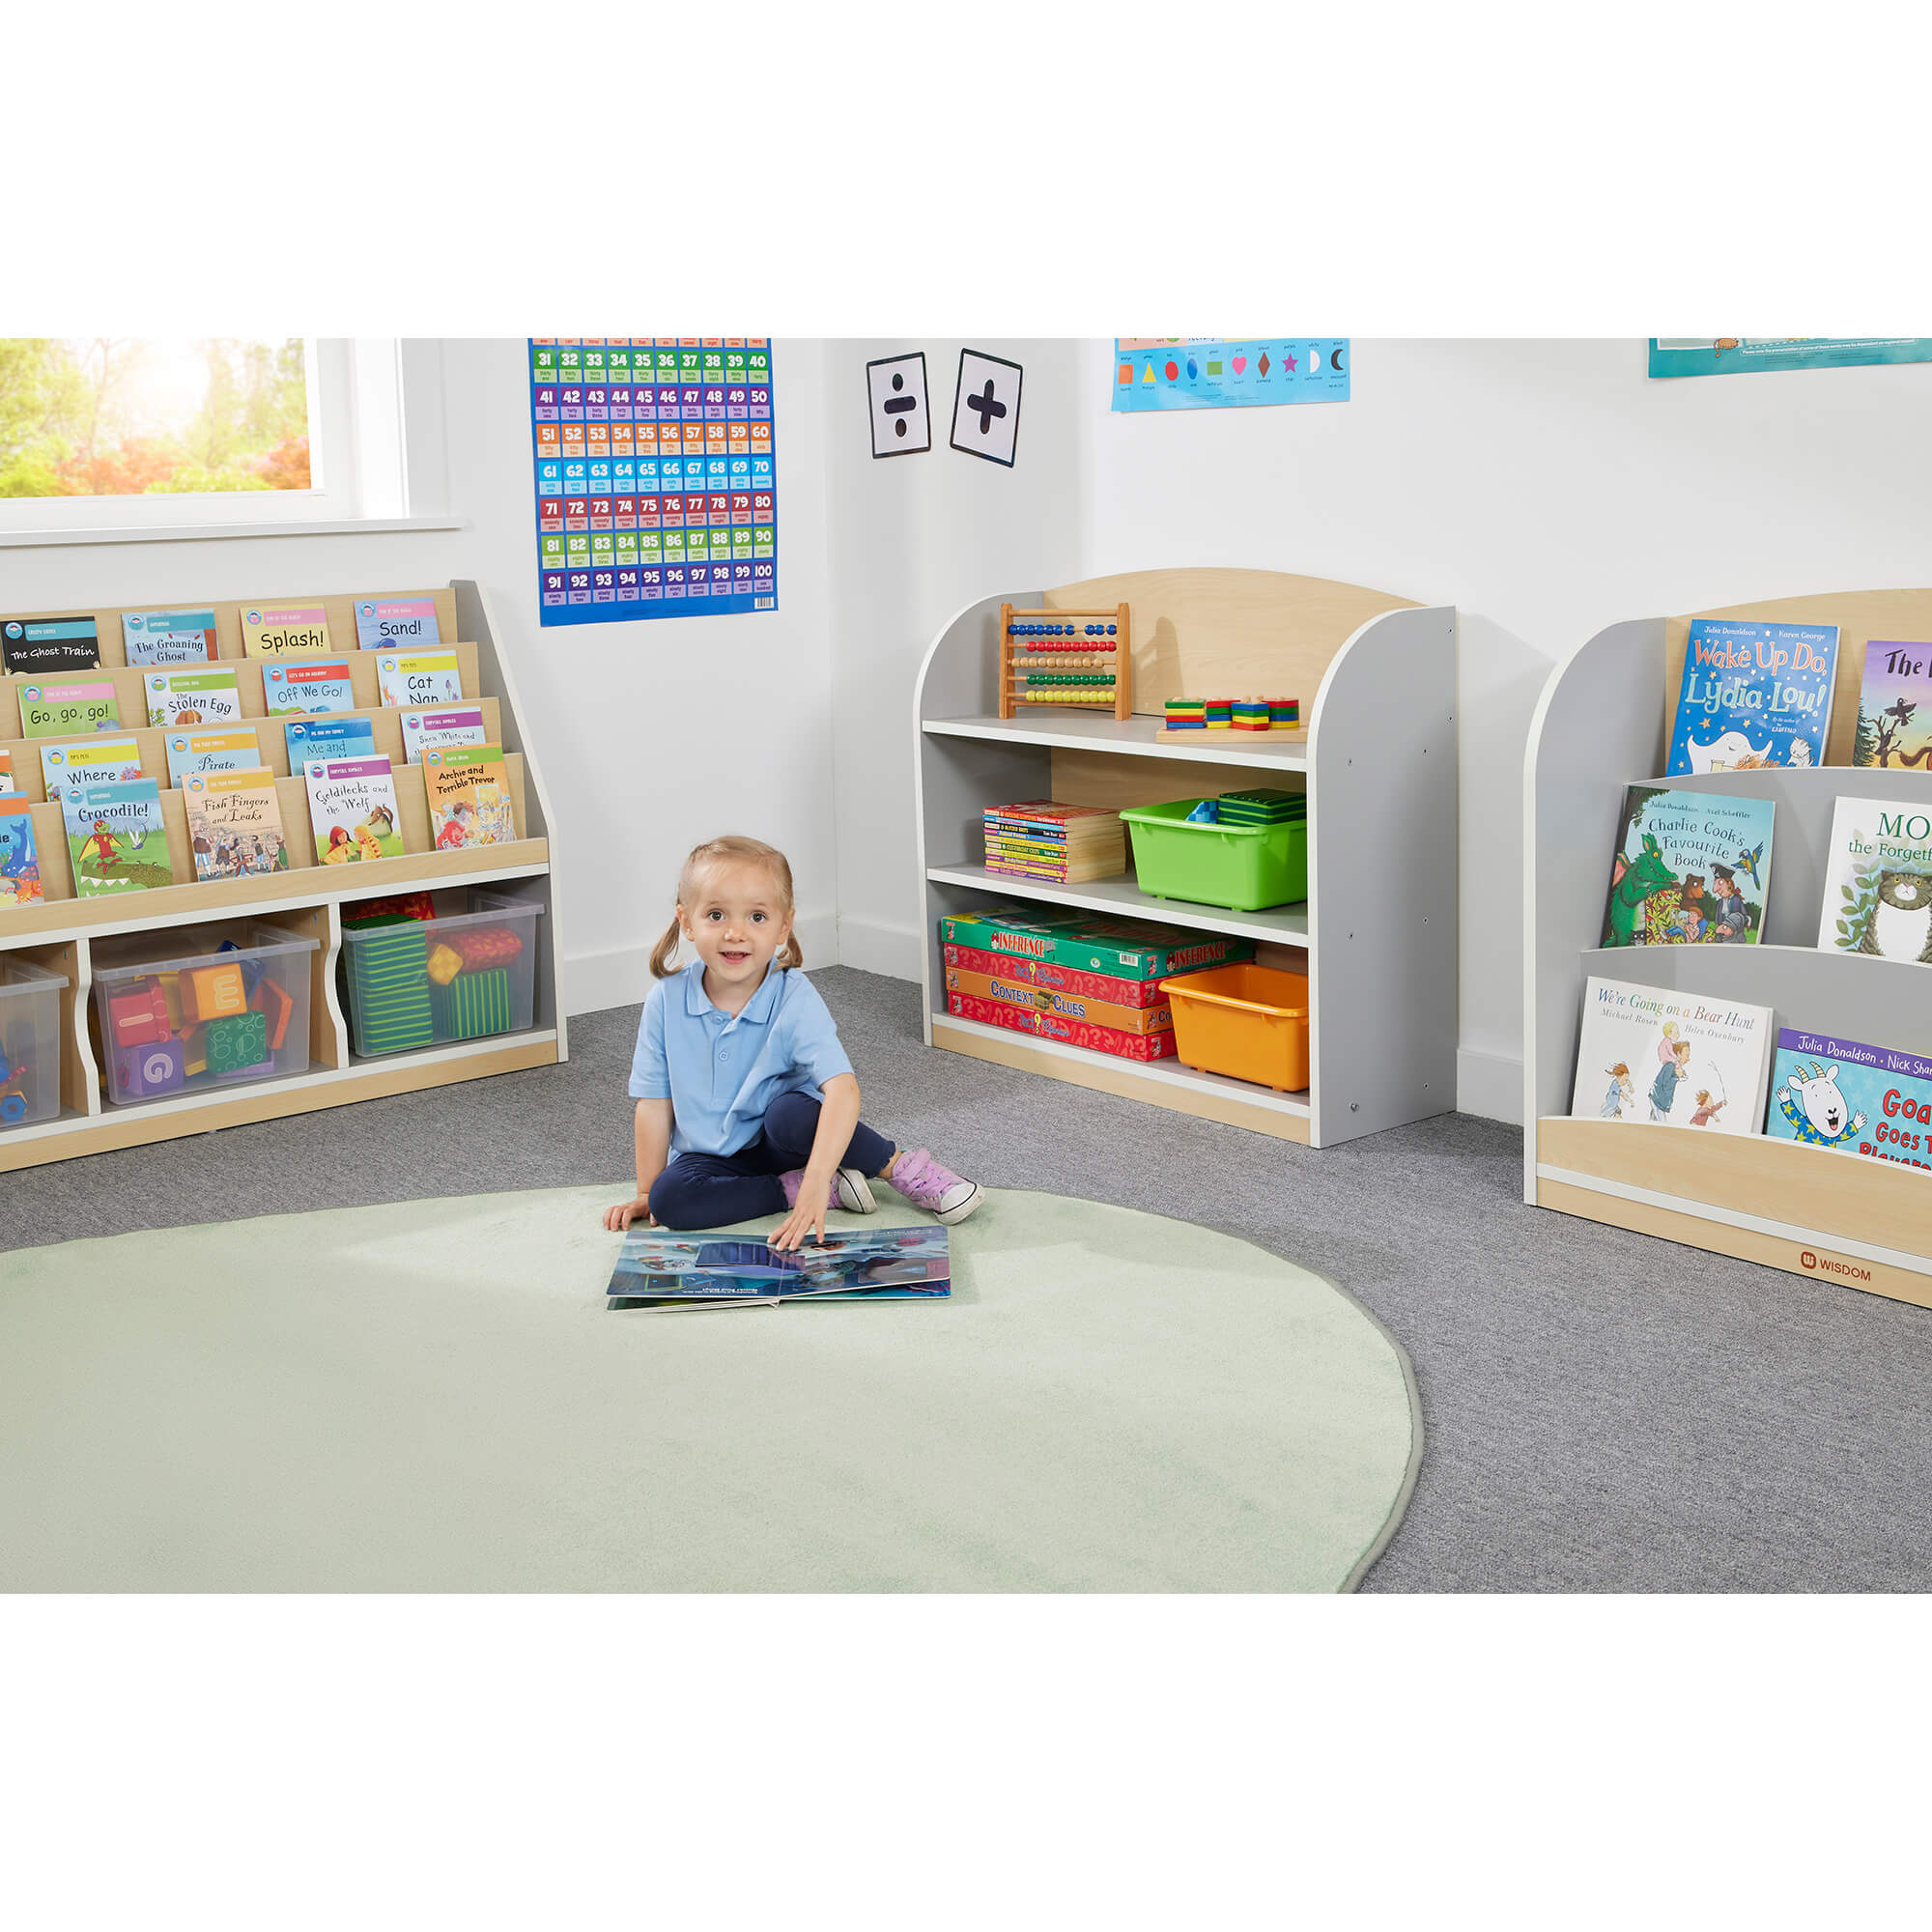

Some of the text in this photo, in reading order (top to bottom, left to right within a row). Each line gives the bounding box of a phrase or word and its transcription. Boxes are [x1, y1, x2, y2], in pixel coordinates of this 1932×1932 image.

[539, 354, 765, 367] 31 32 33 34 35 36 37 38 39 40
[541, 390, 767, 403] 41 42 43 44 45 46 47 48 49 50
[543, 426, 768, 440] 51 52 53 54 55 56 57 58 59 60
[544, 462, 769, 477] 61 62 63 64 65 66 67 68 69 70
[546, 496, 770, 514] 71 72 73 74 75 76 77 78 79 80
[548, 531, 771, 552] 81 82 83 84 85 86 87 88 89 90
[549, 565, 772, 588] 91 92 93 94 95 96 97 98 99 100
[380, 620, 421, 637] Sand!
[1722, 627, 1756, 636] Donaldson
[1802, 633, 1825, 641] George
[134, 639, 204, 654] The Groaning
[261, 630, 324, 653] Splash!
[11, 644, 95, 662] The Ghost Train
[156, 651, 186, 662] Ghost
[1693, 639, 1827, 676] Wake Up Do,
[1885, 649, 1923, 677] The
[409, 676, 433, 689] Cat
[277, 684, 343, 703] Off We Go!
[1685, 673, 1827, 717] Lydia Lou!
[31, 704, 108, 724] Go, go, go!
[168, 697, 232, 715] Stolen Egg
[307, 741, 346, 755] Me and
[198, 754, 235, 771] Pirate
[67, 770, 116, 784] Where
[439, 771, 466, 781] Archie
[316, 782, 368, 805] Goldilocks
[437, 777, 495, 795] Terrible Trevor
[202, 794, 269, 811] Fish Fingers
[342, 798, 370, 812] Wolf
[1650, 801, 1698, 812] Julia Donaldson
[78, 804, 149, 822] Crocodile!
[213, 814, 227, 824] and
[1648, 817, 1746, 847] Charlie Cook's
[1876, 812, 1931, 839] MO
[1662, 836, 1729, 860] Favourite
[1849, 839, 1872, 854] the
[1674, 853, 1707, 869] Book
[999, 931, 1044, 957] INFERENCE
[1175, 942, 1226, 968] INFERENCE
[1598, 988, 1755, 1030] We're Going on a Bear Hunt
[1602, 1009, 1659, 1026] Michael Rosen
[1685, 1024, 1745, 1044] Helen Oxenbury
[1798, 1036, 1823, 1052] Julia
[1827, 1041, 1877, 1064] Donaldson
[1887, 1054, 1911, 1071] Nick
[1883, 1089, 1932, 1125] Goa
[1876, 1122, 1920, 1151] Goes
[1820, 1260, 1870, 1282] WISDOM
